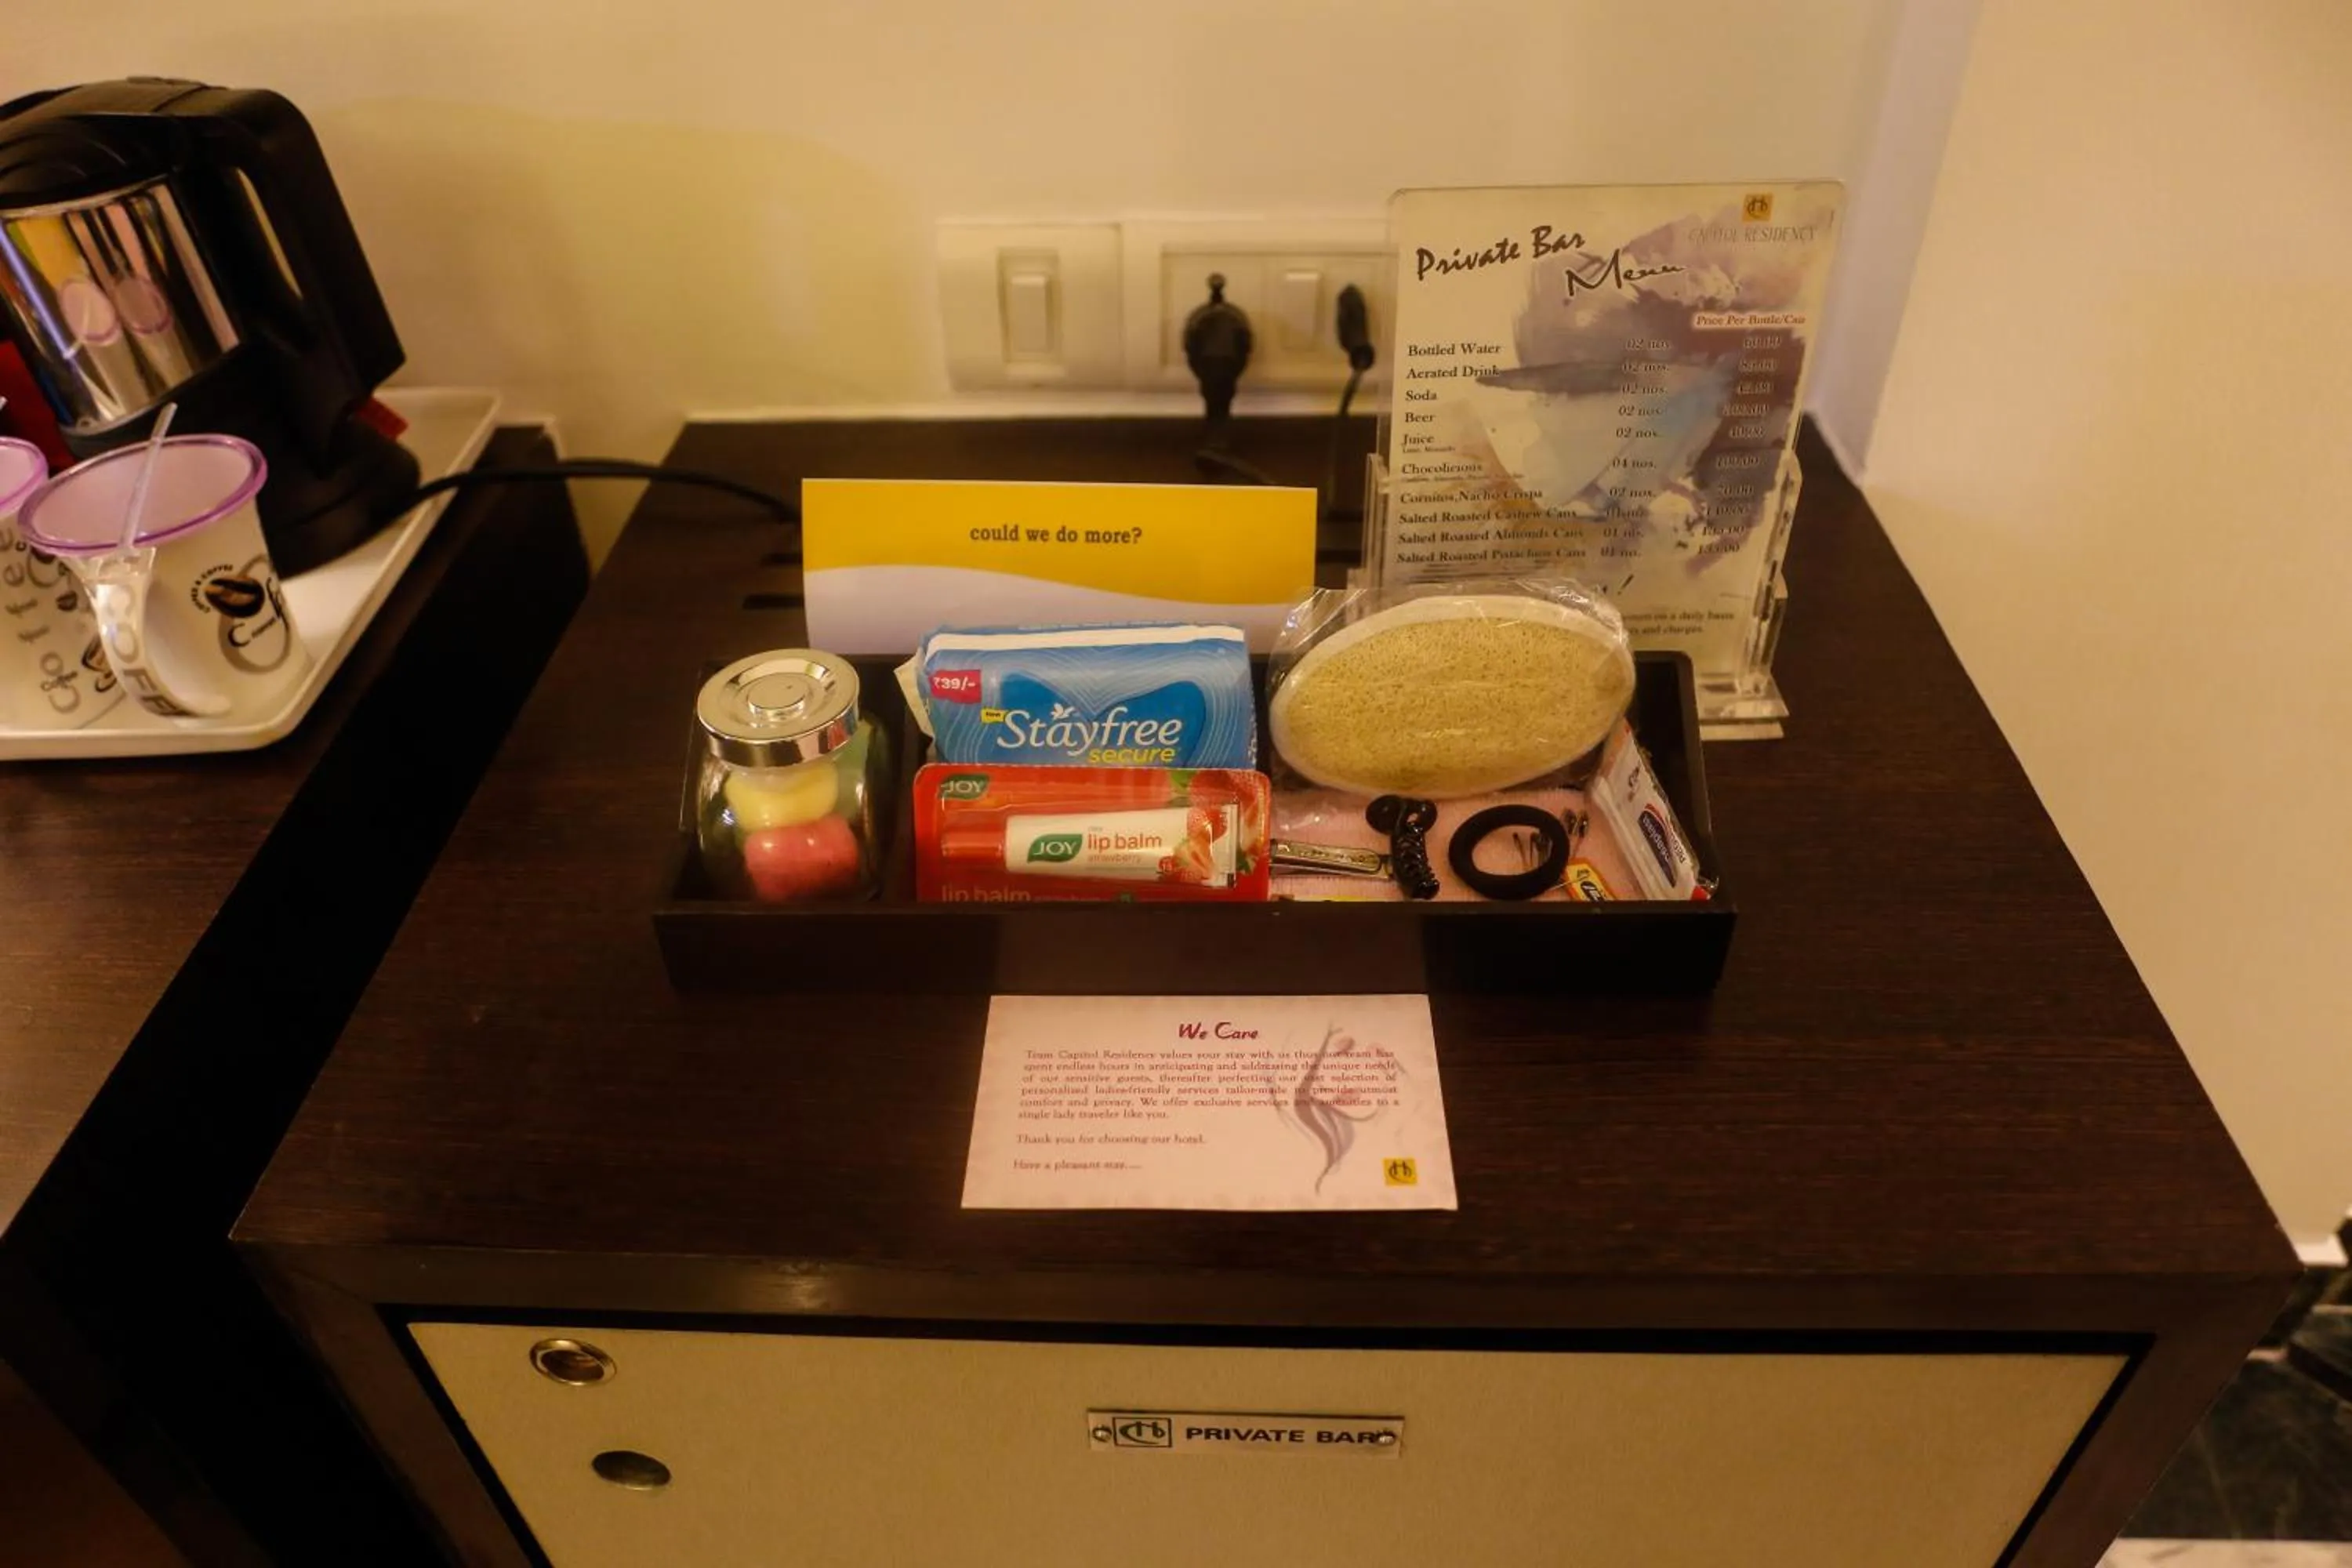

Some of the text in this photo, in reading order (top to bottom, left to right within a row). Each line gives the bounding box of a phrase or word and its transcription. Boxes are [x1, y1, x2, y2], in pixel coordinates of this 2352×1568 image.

[1416, 225, 1585, 281] Private Bar
[1565, 249, 1687, 298] Menu
[1726, 314, 1744, 325] Per
[1407, 343, 1501, 358] Bottled Water
[1406, 365, 1501, 379] Aerated Drink
[1405, 390, 1438, 402] Soda
[1618, 405, 1635, 416] 02
[1405, 412, 1436, 424] Beer
[1402, 433, 1436, 446] Juice
[1616, 427, 1632, 438] 02
[1399, 512, 1438, 524] Salted
[1442, 510, 1492, 522] Roasted
[1495, 508, 1542, 521] Cashew
[969, 524, 1142, 545] could we do more?
[1398, 532, 1436, 544] Salted
[1440, 530, 1490, 543] Roasted
[1494, 528, 1549, 541] Almonds
[1396, 551, 1436, 564] Salted
[1439, 549, 1488, 561] Roasted
[996, 706, 1183, 757] Stayfree
[1087, 744, 1177, 764] secure
[943, 779, 985, 796] JOY
[1034, 838, 1080, 857] JOY
[1087, 833, 1162, 853] lip balm
[1178, 1021, 1260, 1040] We Care
[1103, 1050, 1155, 1060] Residency
[1160, 1049, 1192, 1058] values
[1225, 1051, 1246, 1060] stay
[1250, 1050, 1274, 1058] with
[1376, 1049, 1394, 1058] has
[1056, 1062, 1095, 1070] endless
[1099, 1062, 1130, 1070] hours
[1149, 1062, 1214, 1072] anticipating
[1217, 1062, 1237, 1070] and
[1323, 1062, 1361, 1072] unique
[1022, 1074, 1034, 1083] of
[1065, 1074, 1111, 1083] sensitive
[1159, 1074, 1210, 1083] thereafter
[1069, 1098, 1089, 1107] and
[1140, 1097, 1158, 1106] We
[1193, 1097, 1243, 1106] exclusive
[1018, 1109, 1049, 1120] single
[1079, 1109, 1120, 1119] traveler
[1123, 1109, 1145, 1118] like
[1016, 1134, 1052, 1144] Thank
[1056, 1136, 1075, 1145] you
[1079, 1134, 1094, 1144] for
[1098, 1134, 1148, 1145] choosing
[1013, 1160, 1041, 1170] Have
[1054, 1160, 1100, 1171] pleasant
[1185, 1427, 1305, 1443] PRIVATE
[1316, 1429, 1378, 1445] BAR
